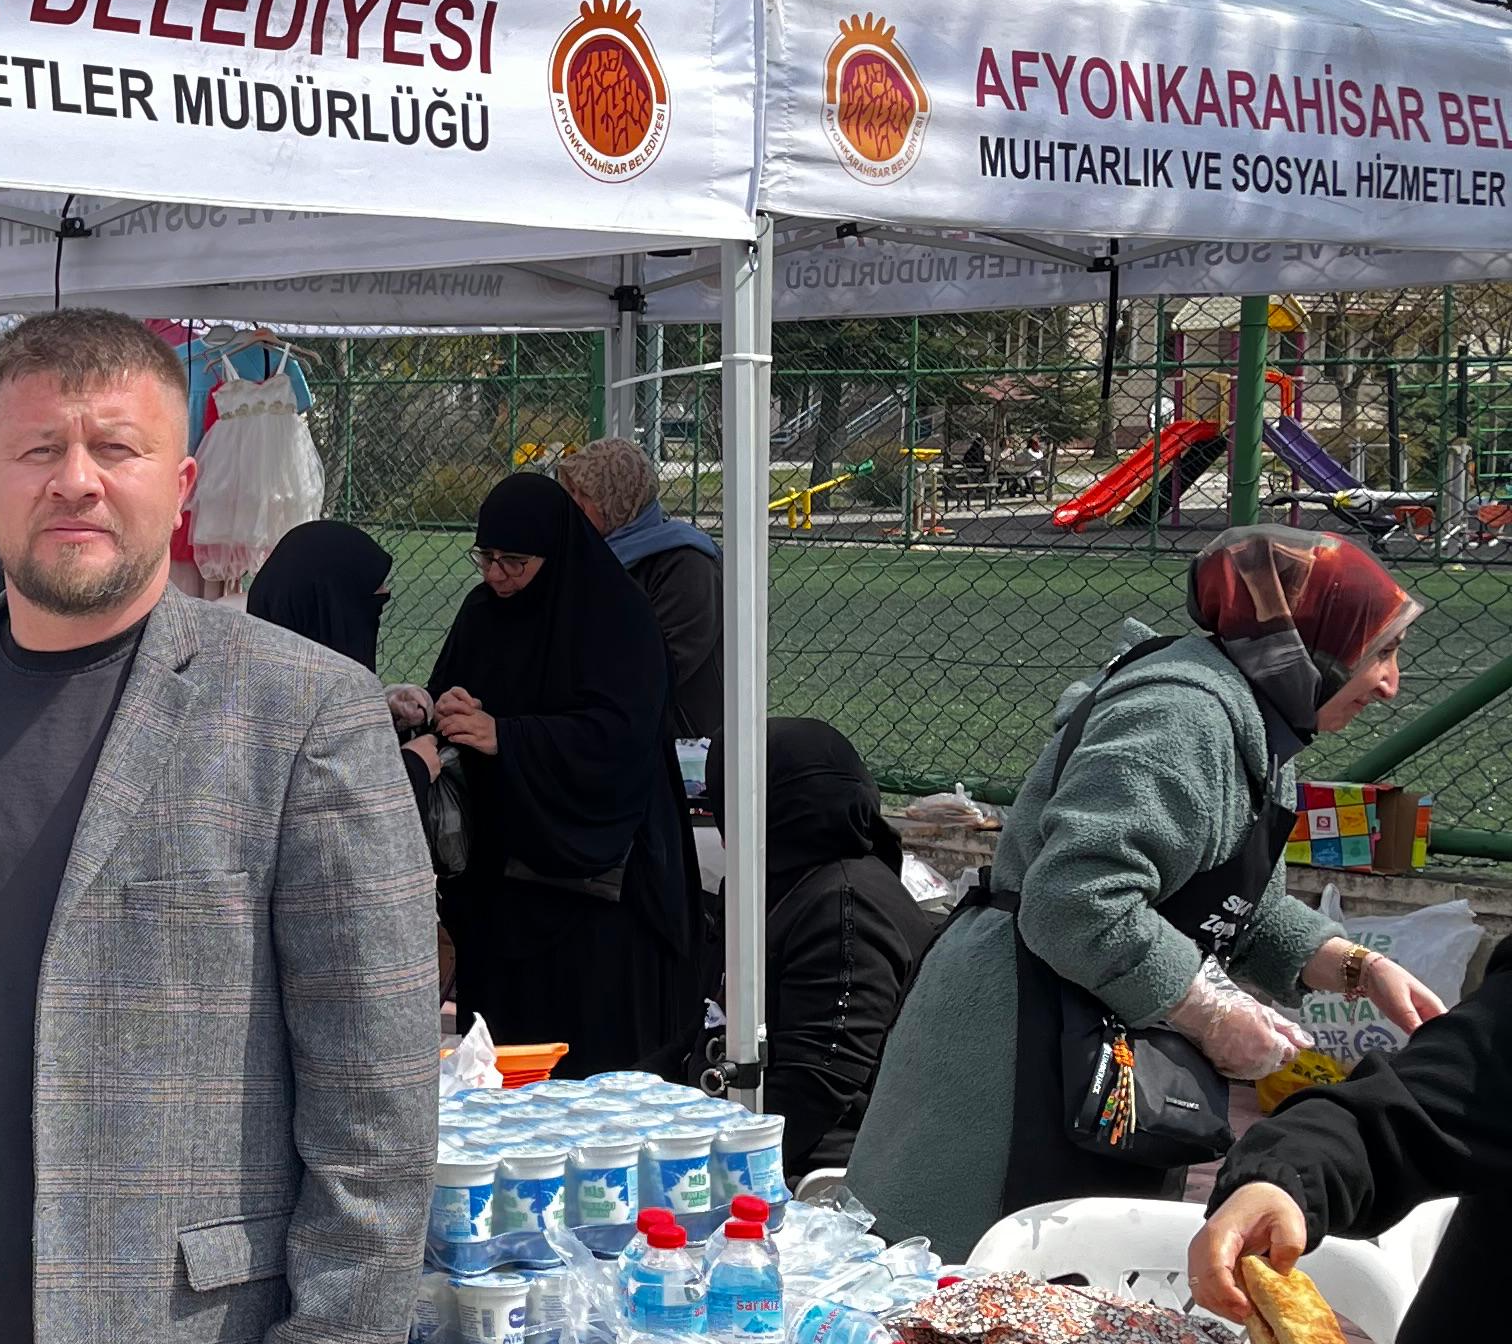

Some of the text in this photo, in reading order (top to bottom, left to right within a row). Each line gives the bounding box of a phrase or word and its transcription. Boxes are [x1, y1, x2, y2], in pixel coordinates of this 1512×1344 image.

[174, 66, 490, 152] MÜDÜRLÜĞÜ
[975, 47, 1432, 143] AFYONKARAHİSAR
[556, 98, 627, 175] AFYONKARAHİSAR
[979, 136, 1506, 207] MUHTARLIK VE SOSYAL HİZMETLER
